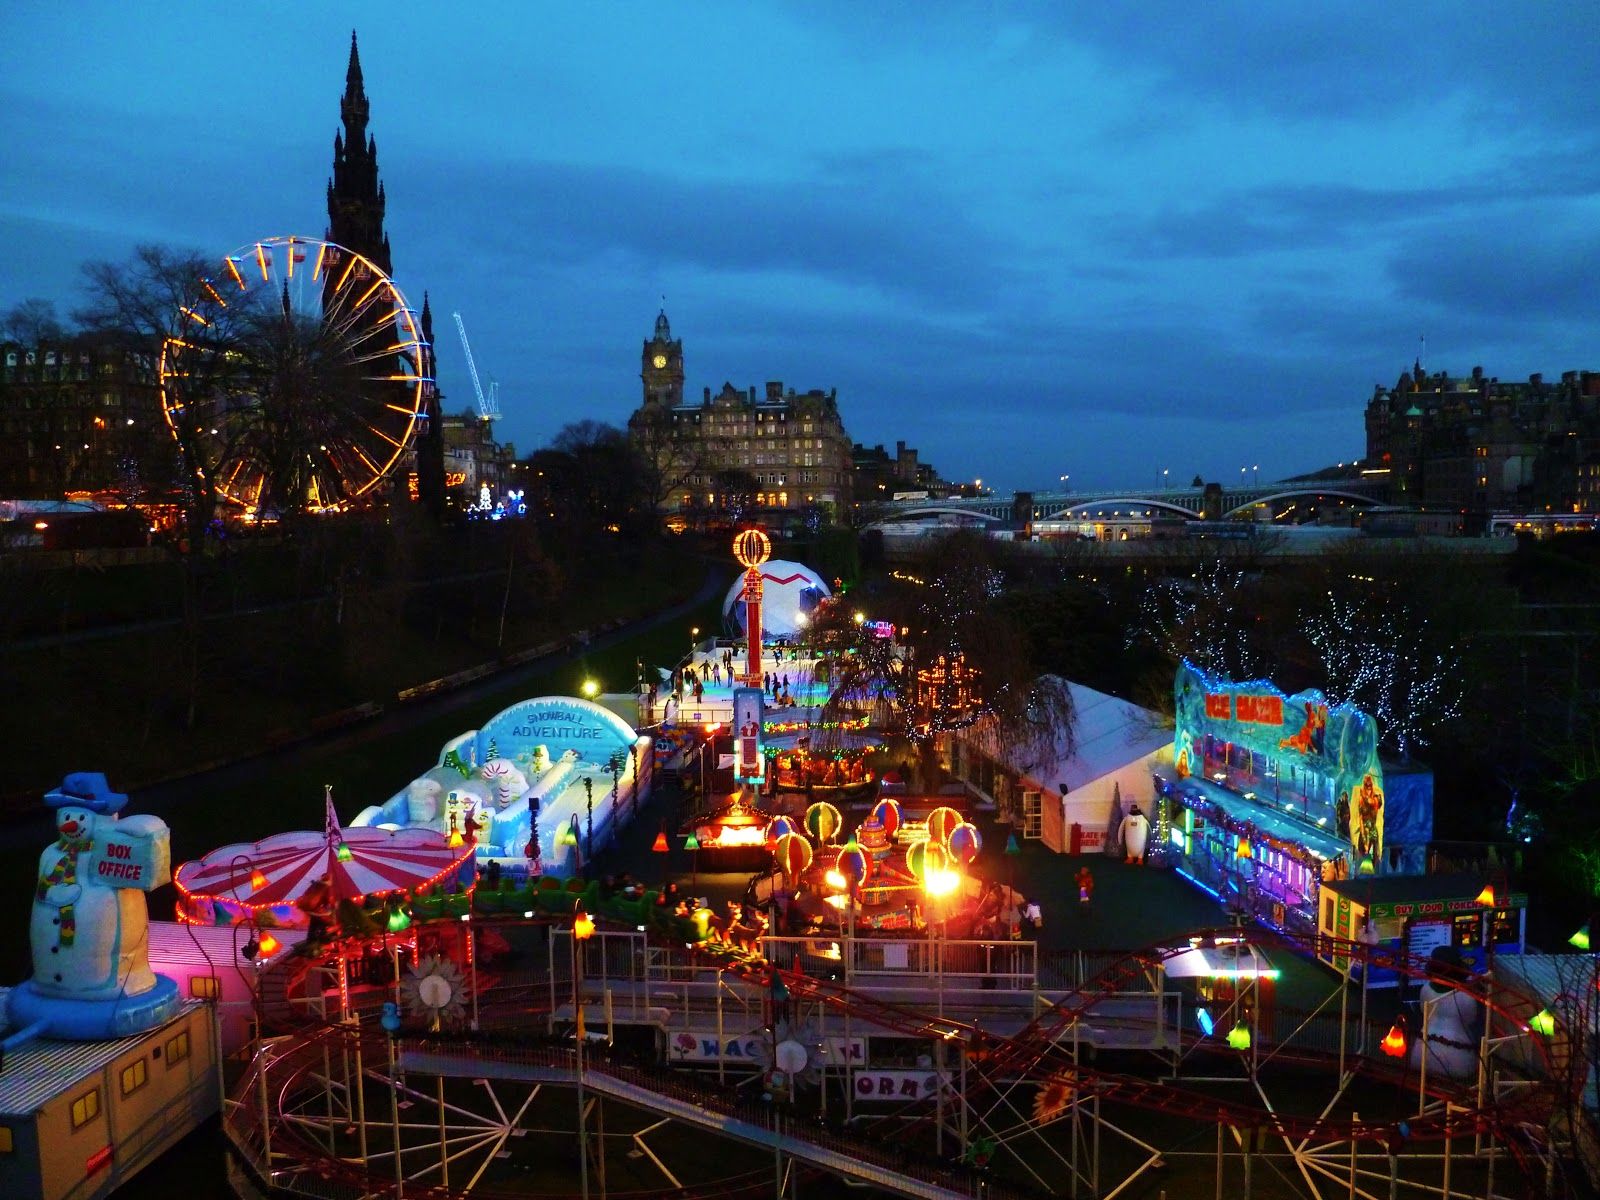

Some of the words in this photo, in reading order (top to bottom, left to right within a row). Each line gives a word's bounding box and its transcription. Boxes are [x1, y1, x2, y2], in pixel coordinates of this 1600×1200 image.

[527, 711, 584, 726] SNOWBALL
[512, 726, 603, 739] ADVENTURE
[107, 843, 132, 859] BOX
[98, 861, 143, 880] OFFICE
[1395, 904, 1414, 915] BUY
[1419, 903, 1443, 913] YOUR
